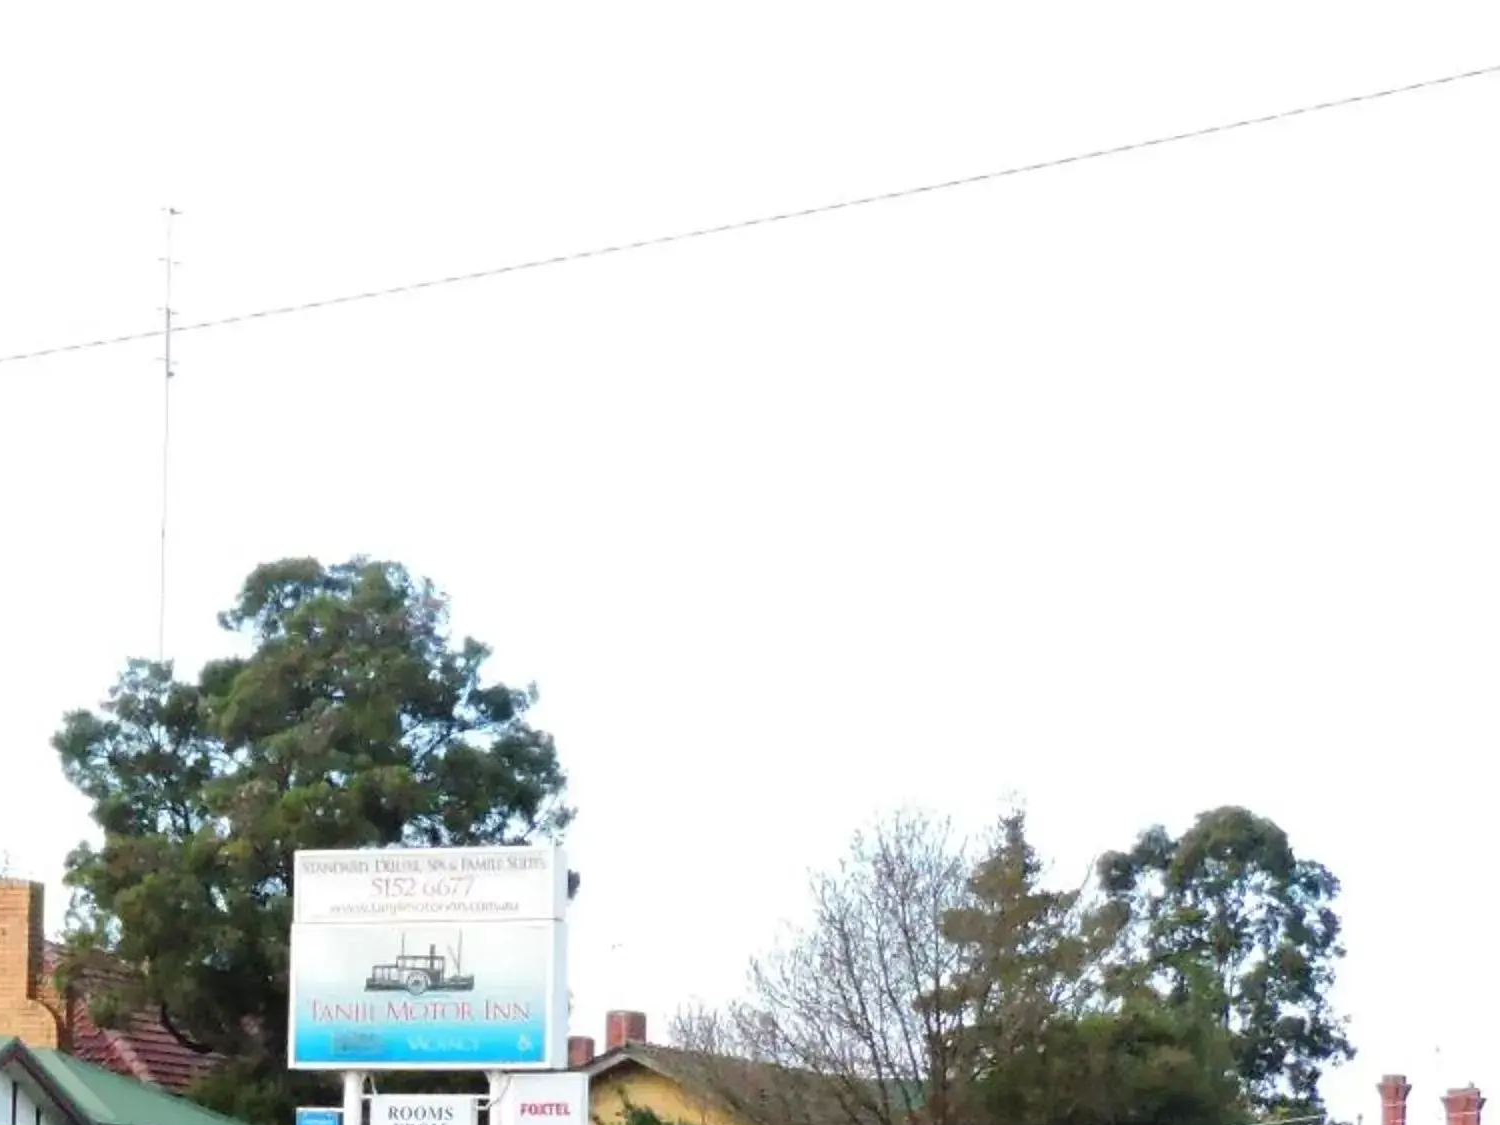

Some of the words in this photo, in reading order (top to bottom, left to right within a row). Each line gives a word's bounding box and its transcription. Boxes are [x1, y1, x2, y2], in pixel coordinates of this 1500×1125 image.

[371, 876, 417, 898] 5152
[422, 874, 475, 897] 6677
[386, 999, 474, 1023] MOTOR
[485, 998, 531, 1023] INN
[388, 1105, 454, 1121] ROOMS
[520, 1102, 570, 1116] FOXTEL
